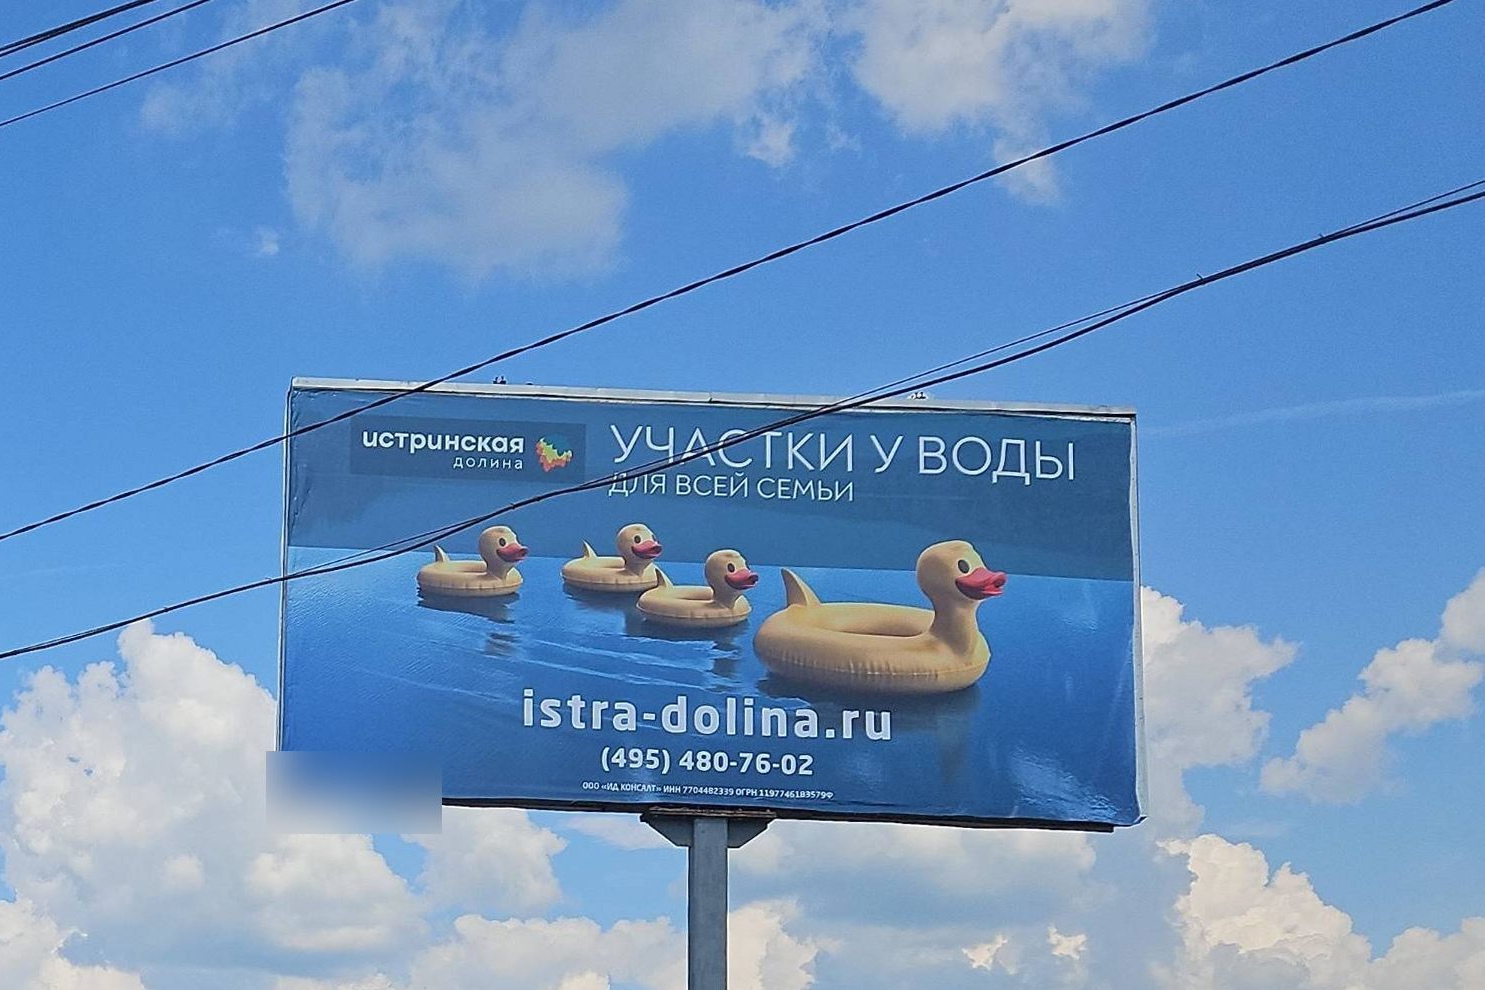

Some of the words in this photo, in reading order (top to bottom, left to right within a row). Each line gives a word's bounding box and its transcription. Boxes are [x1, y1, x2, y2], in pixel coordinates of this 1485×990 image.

[362, 430, 525, 454] истринская
[610, 424, 854, 472] УЧАСТКИ
[870, 434, 904, 474] У
[918, 435, 1075, 486] ВОДЫ
[453, 456, 524, 471] долина
[608, 472, 666, 497] ДЛЯ
[675, 472, 749, 498] ВСЕЙ
[757, 477, 854, 502] СЕМЬИ
[522, 688, 893, 741] istra-dolina.ru
[601, 747, 671, 775] (495)
[679, 749, 814, 776] 480-76-02
[663, 785, 681, 794] ИНН
[735, 788, 757, 797] ОГРН
